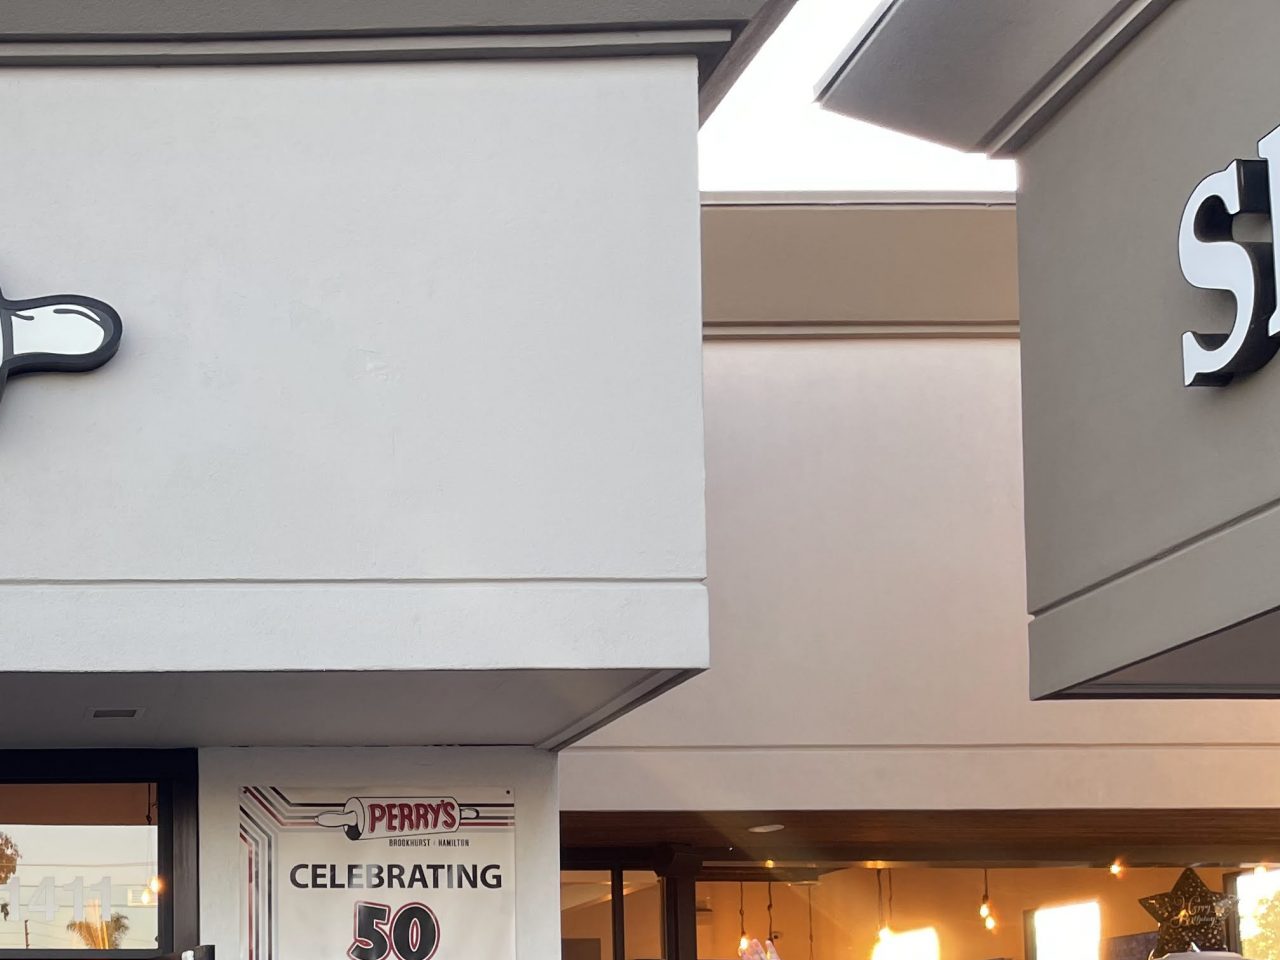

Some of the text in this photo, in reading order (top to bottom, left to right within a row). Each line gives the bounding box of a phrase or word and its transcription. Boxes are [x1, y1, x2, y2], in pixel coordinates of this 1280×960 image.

[1178, 124, 1280, 387] S
[368, 799, 457, 833] PERRY'S
[388, 838, 470, 848] BROOKHURST HAMILTON
[289, 863, 502, 889] CELEBRATING
